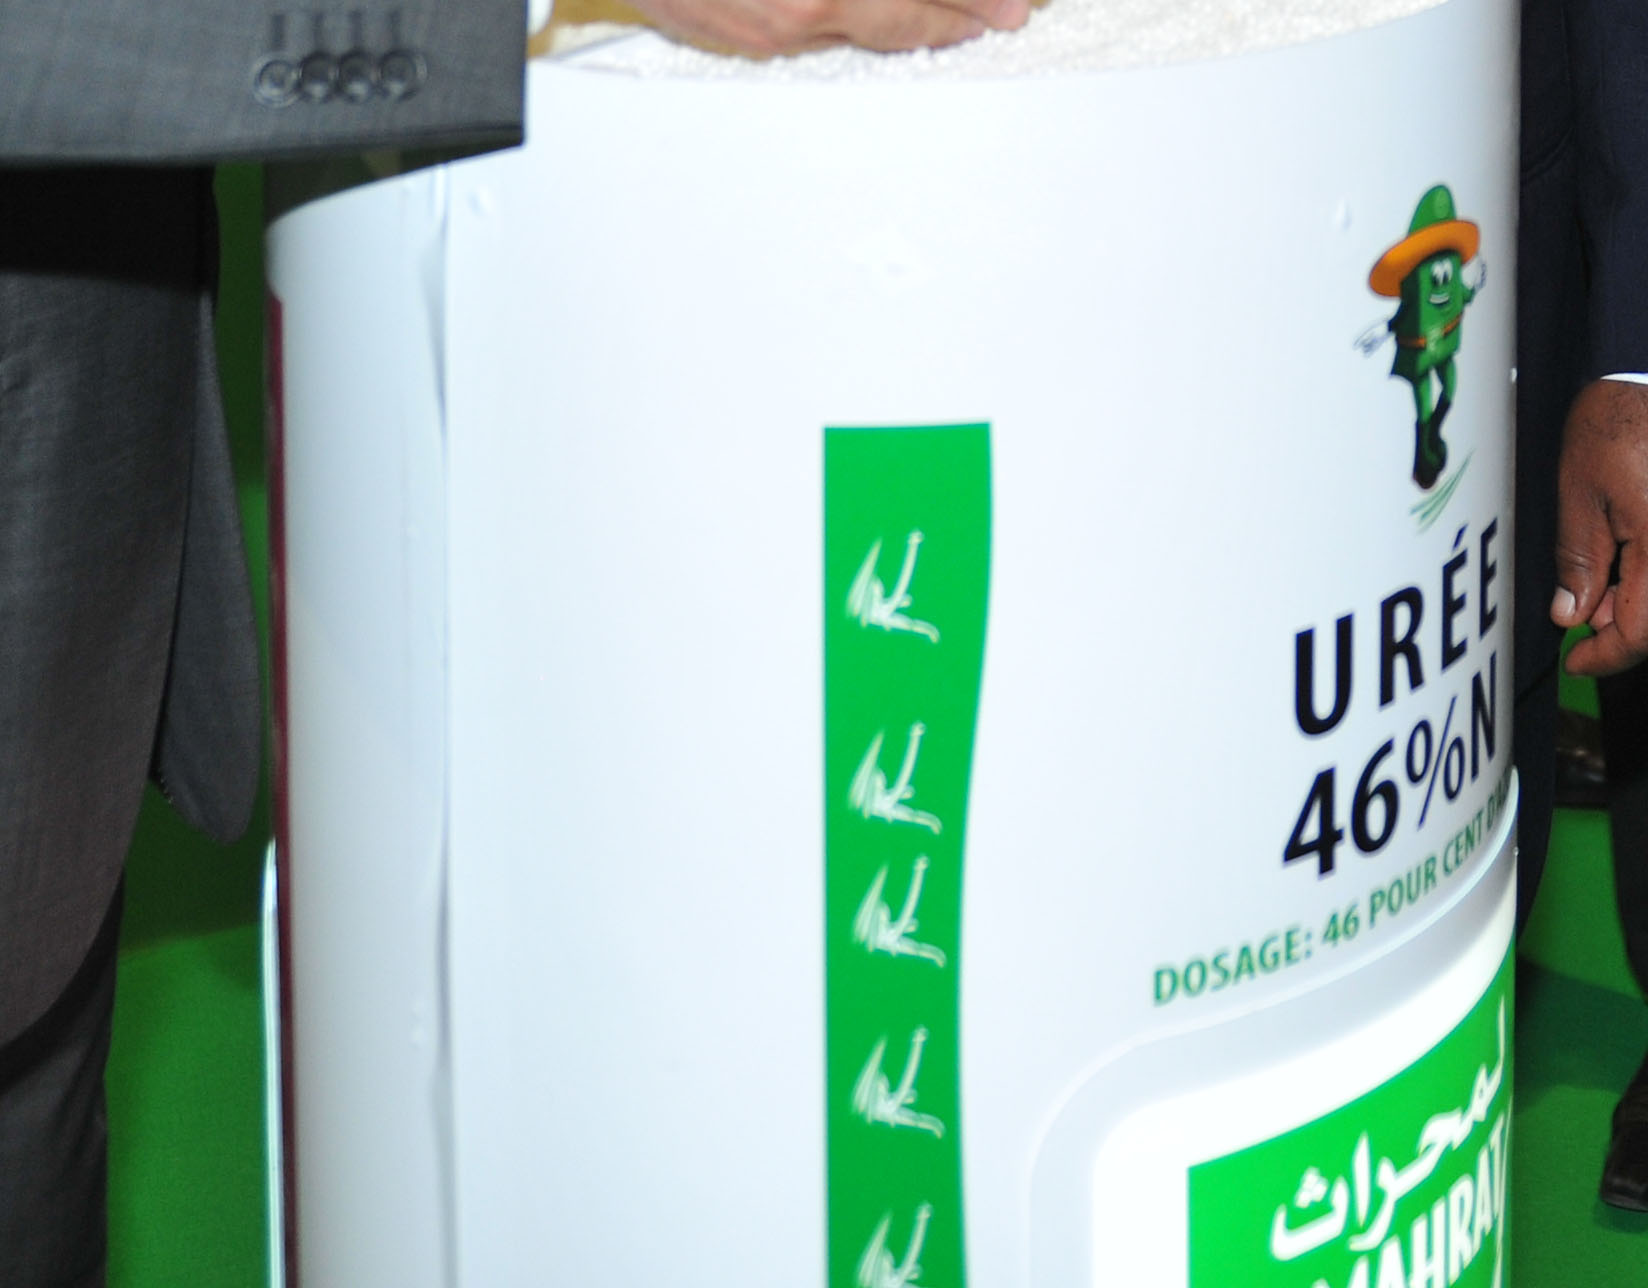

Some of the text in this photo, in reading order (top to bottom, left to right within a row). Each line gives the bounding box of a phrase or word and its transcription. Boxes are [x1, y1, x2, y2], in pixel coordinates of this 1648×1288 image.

[1294, 518, 1499, 737] URÉE
[1283, 651, 1497, 877] 46%N
[1152, 927, 1314, 1006] DOSAGE:
[1322, 902, 1361, 947] 46
[1368, 853, 1439, 929] POUR
[1442, 808, 1485, 877] CENT
[1270, 995, 1506, 1262] لمحراث
